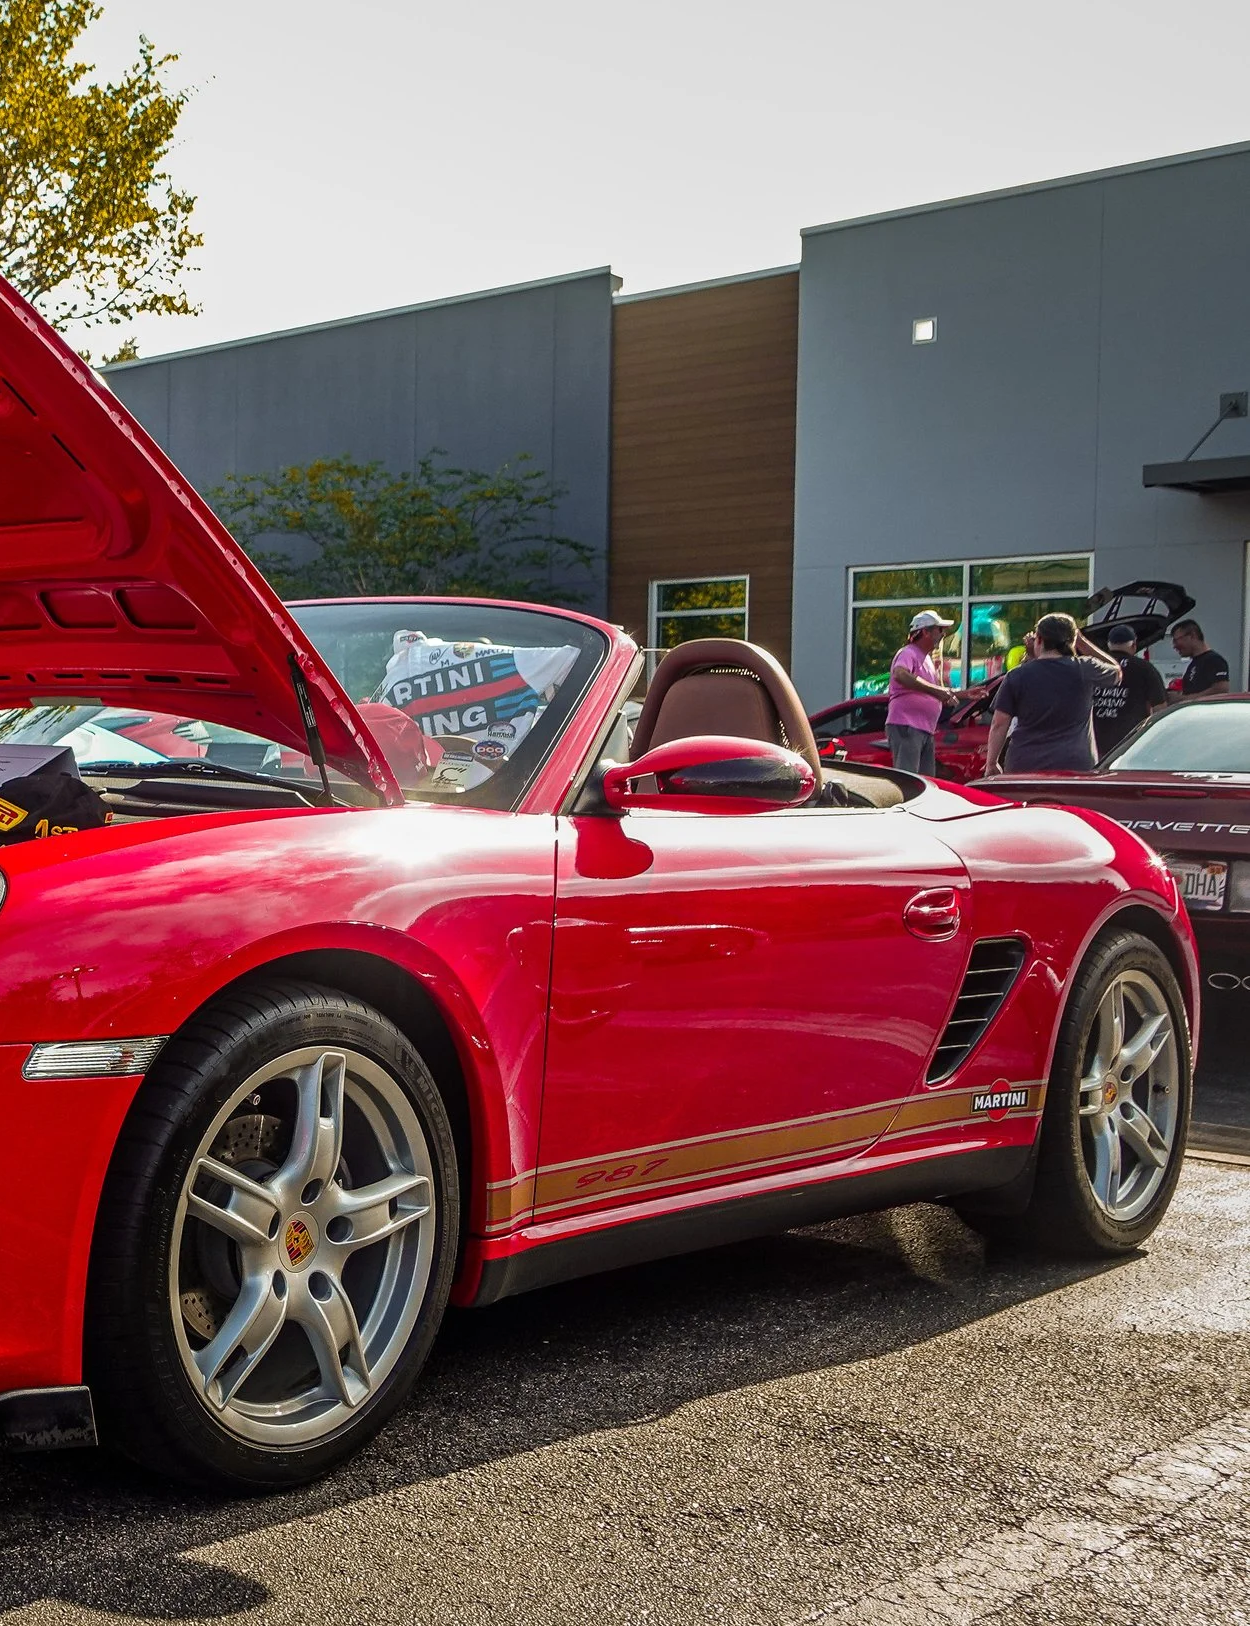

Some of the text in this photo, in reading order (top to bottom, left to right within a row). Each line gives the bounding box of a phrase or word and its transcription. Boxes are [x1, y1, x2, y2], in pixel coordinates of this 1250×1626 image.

[380, 661, 484, 707] RTINI
[415, 705, 488, 736] ING
[1115, 819, 1250, 835] ORVETTE
[974, 1091, 1027, 1110] MARTINI
[574, 1158, 670, 1189] 987
